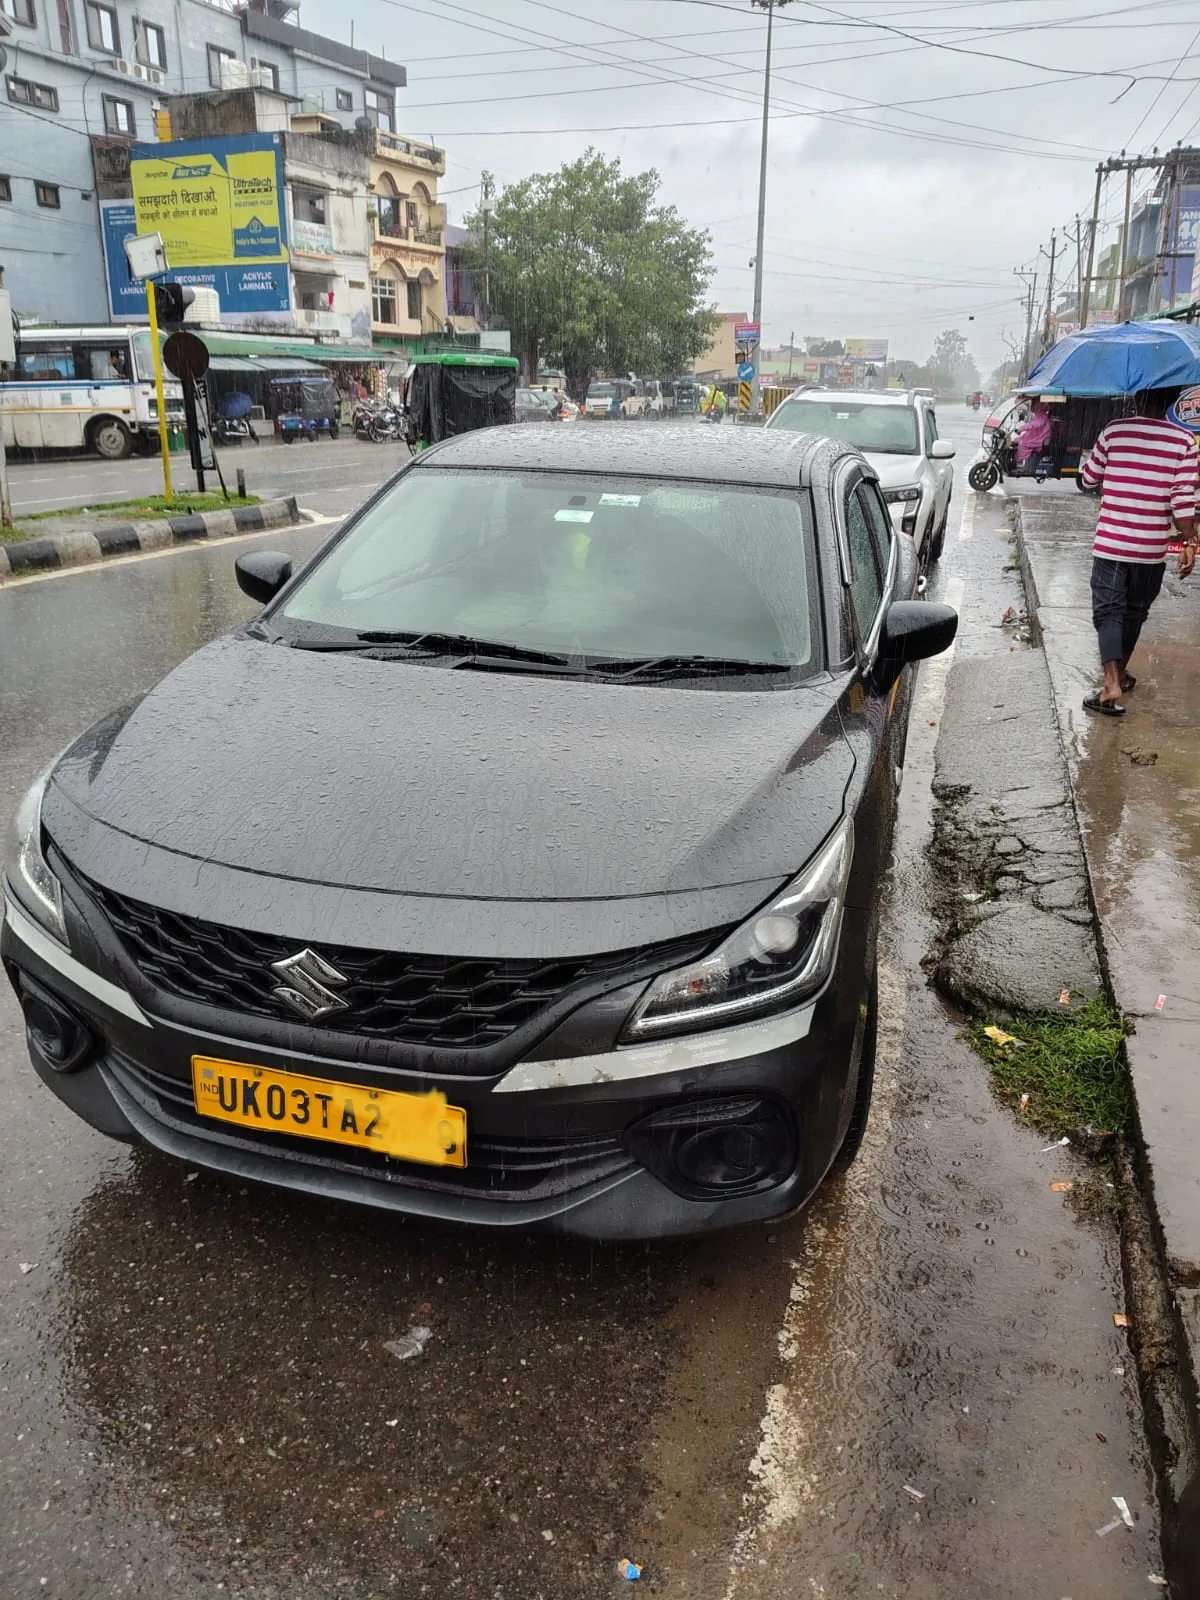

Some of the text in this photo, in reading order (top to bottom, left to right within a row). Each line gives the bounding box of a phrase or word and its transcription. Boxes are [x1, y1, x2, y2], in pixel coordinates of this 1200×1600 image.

[233, 177, 272, 189] UltraTech
[139, 191, 178, 208] समझदारी
[242, 271, 273, 281] ACRYLIC
[200, 1082, 219, 1095] IND
